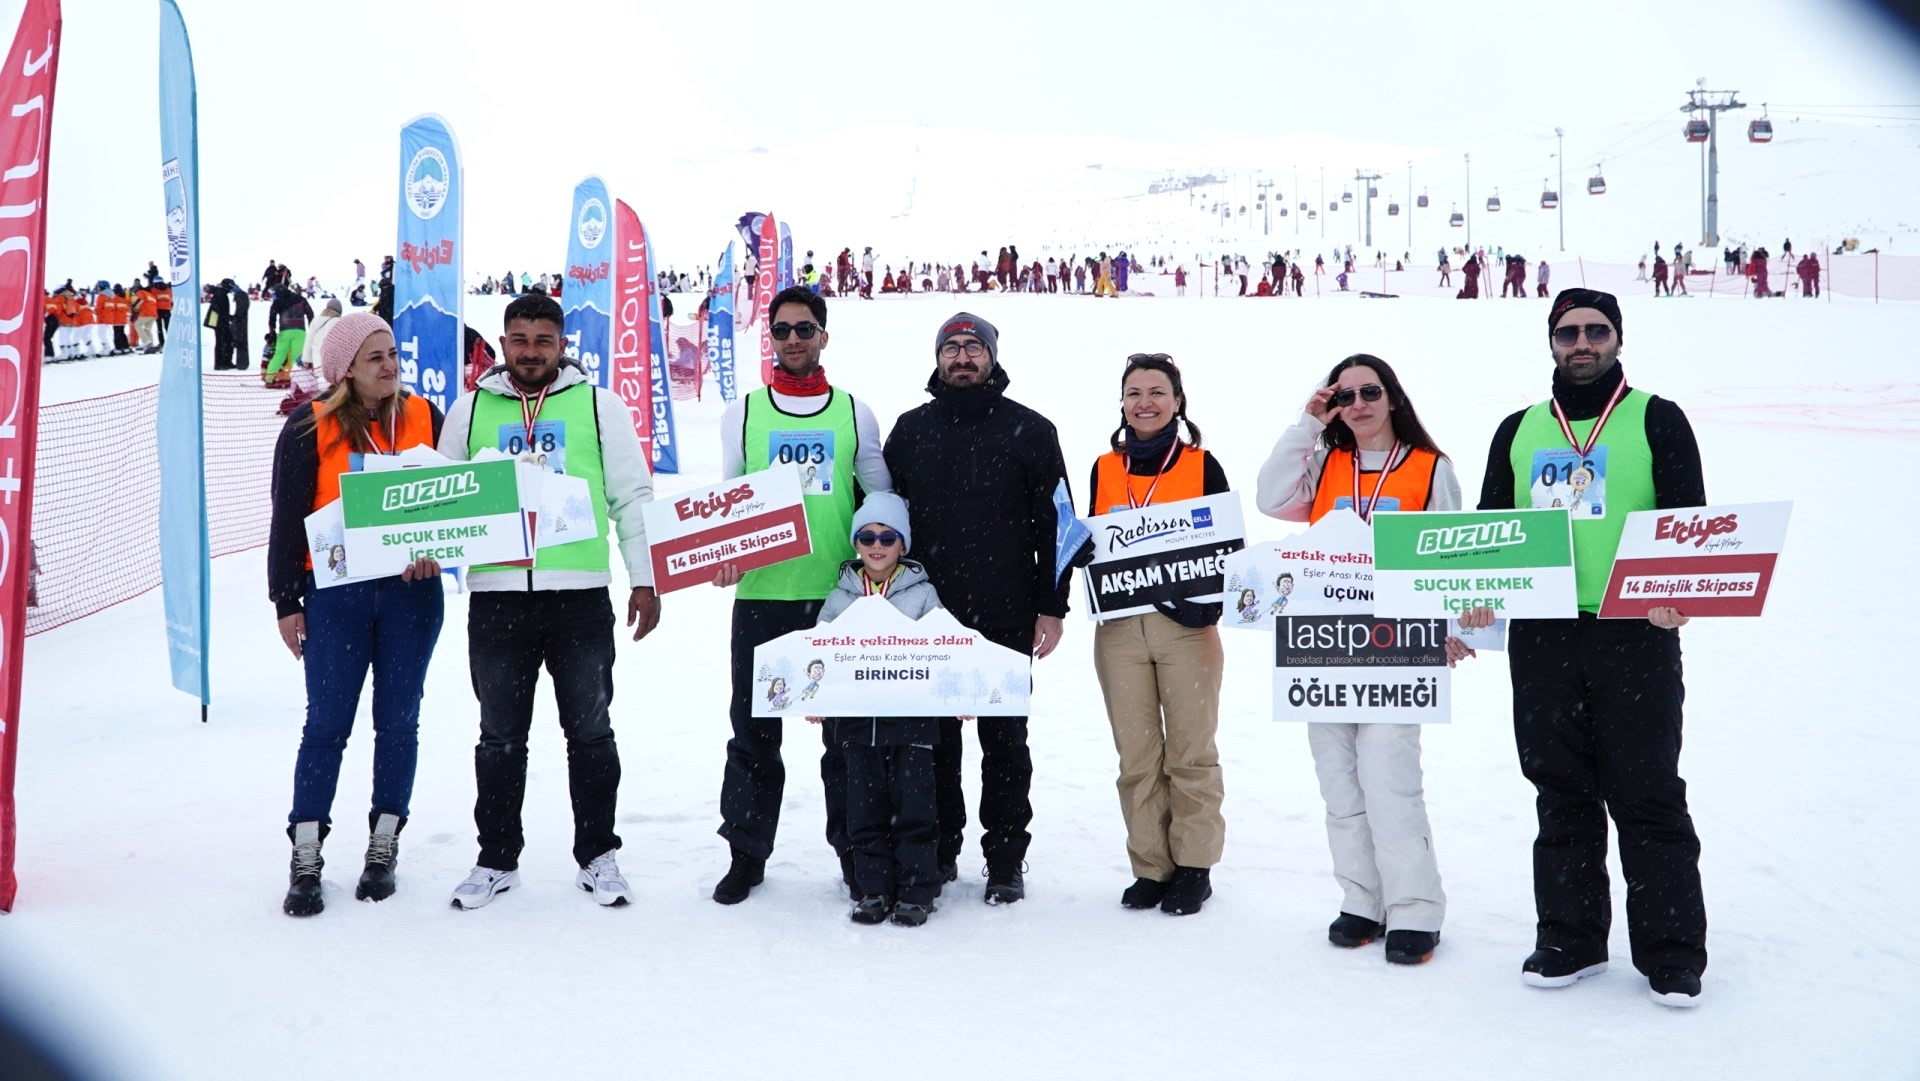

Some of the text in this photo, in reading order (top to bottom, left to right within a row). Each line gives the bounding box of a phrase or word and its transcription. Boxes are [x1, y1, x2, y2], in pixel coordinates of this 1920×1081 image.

[509, 432, 556, 455] 018
[778, 442, 825, 464] 003
[382, 471, 480, 511] BUZULL
[674, 484, 754, 521] Erciyes
[382, 524, 488, 546] SUCUK EKMEK
[1106, 516, 1191, 554] Radisson
[1165, 536, 1188, 544] MOUNT
[1416, 520, 1526, 555] BUZULL
[1655, 514, 1737, 548] Erciyes
[671, 530, 793, 570] 14 Binişlik Skipass
[1101, 547, 1232, 596] AKŞAM YEMEĞ
[1303, 568, 1326, 578] Eşler
[1328, 570, 1351, 579] Arası
[1414, 577, 1533, 591] SUCUK EKMEK
[1626, 579, 1754, 596] 14 Binişlik Skipass
[860, 636, 929, 648] çekilmez
[1288, 617, 1439, 656] lastpoint
[834, 653, 856, 663] Eşler
[910, 653, 950, 662] Yarışması
[1286, 655, 1440, 665] breakfast patisserie chocolate coffee
[855, 667, 929, 680] BİRİNCİSİ
[1288, 677, 1437, 707] ÖĞLE YEMEĞİ
